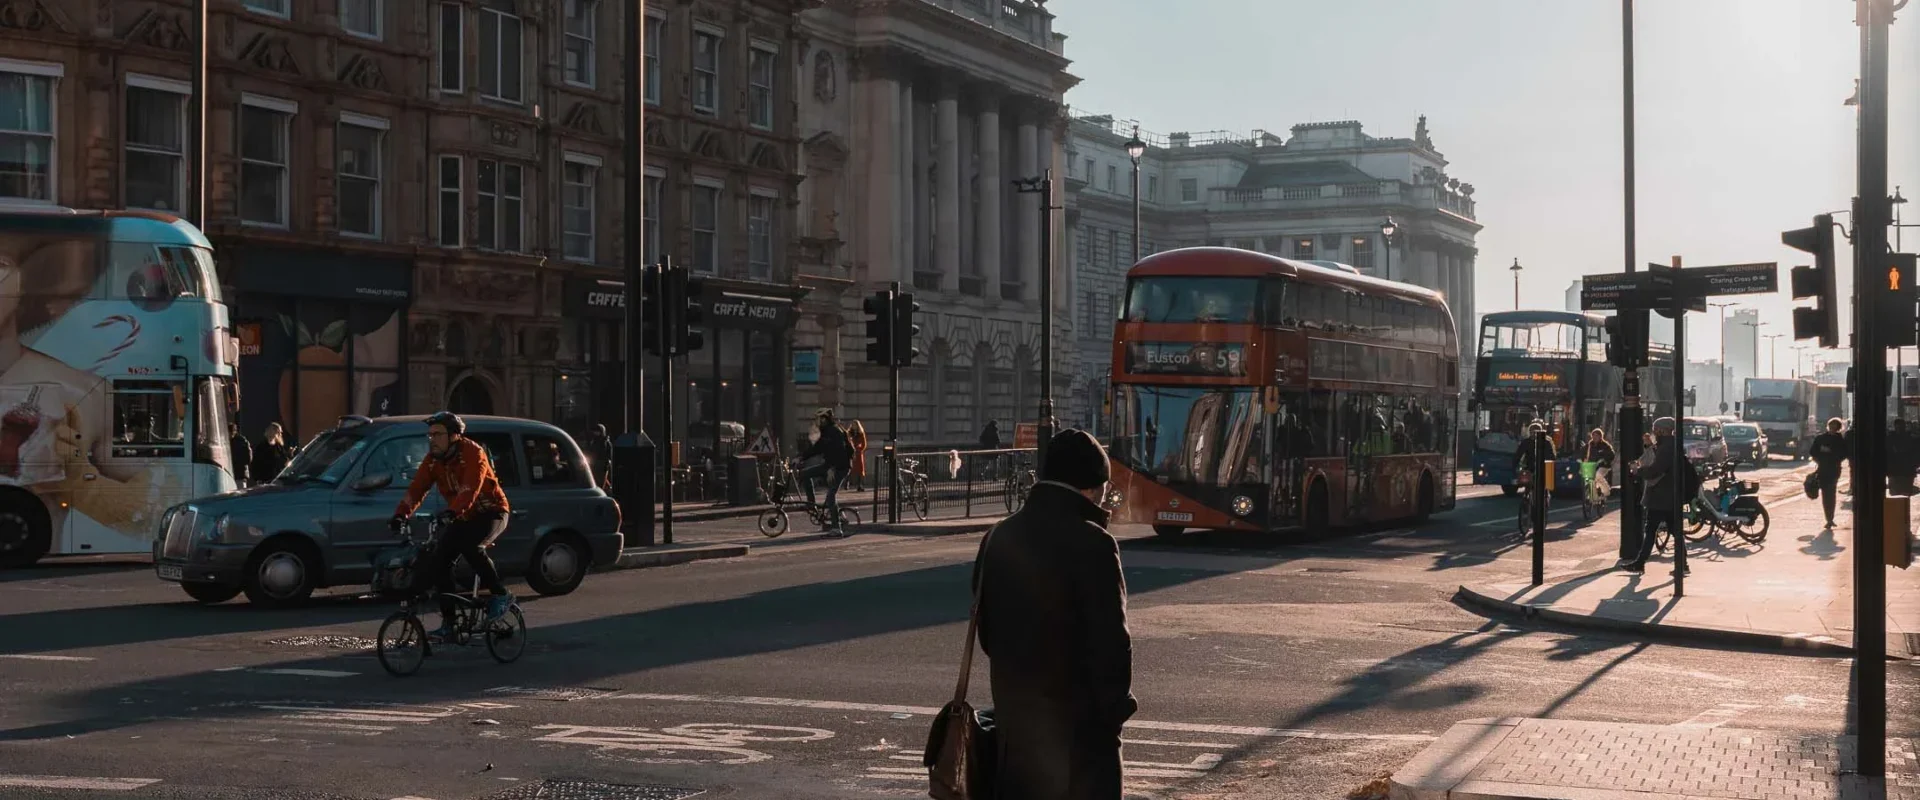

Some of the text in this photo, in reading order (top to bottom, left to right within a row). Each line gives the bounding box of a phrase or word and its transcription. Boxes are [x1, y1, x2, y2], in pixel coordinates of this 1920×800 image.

[1710, 277, 1733, 285] Charing
[713, 301, 777, 319] CAFFÈ NERO
[1147, 349, 1241, 369] Euston 59
